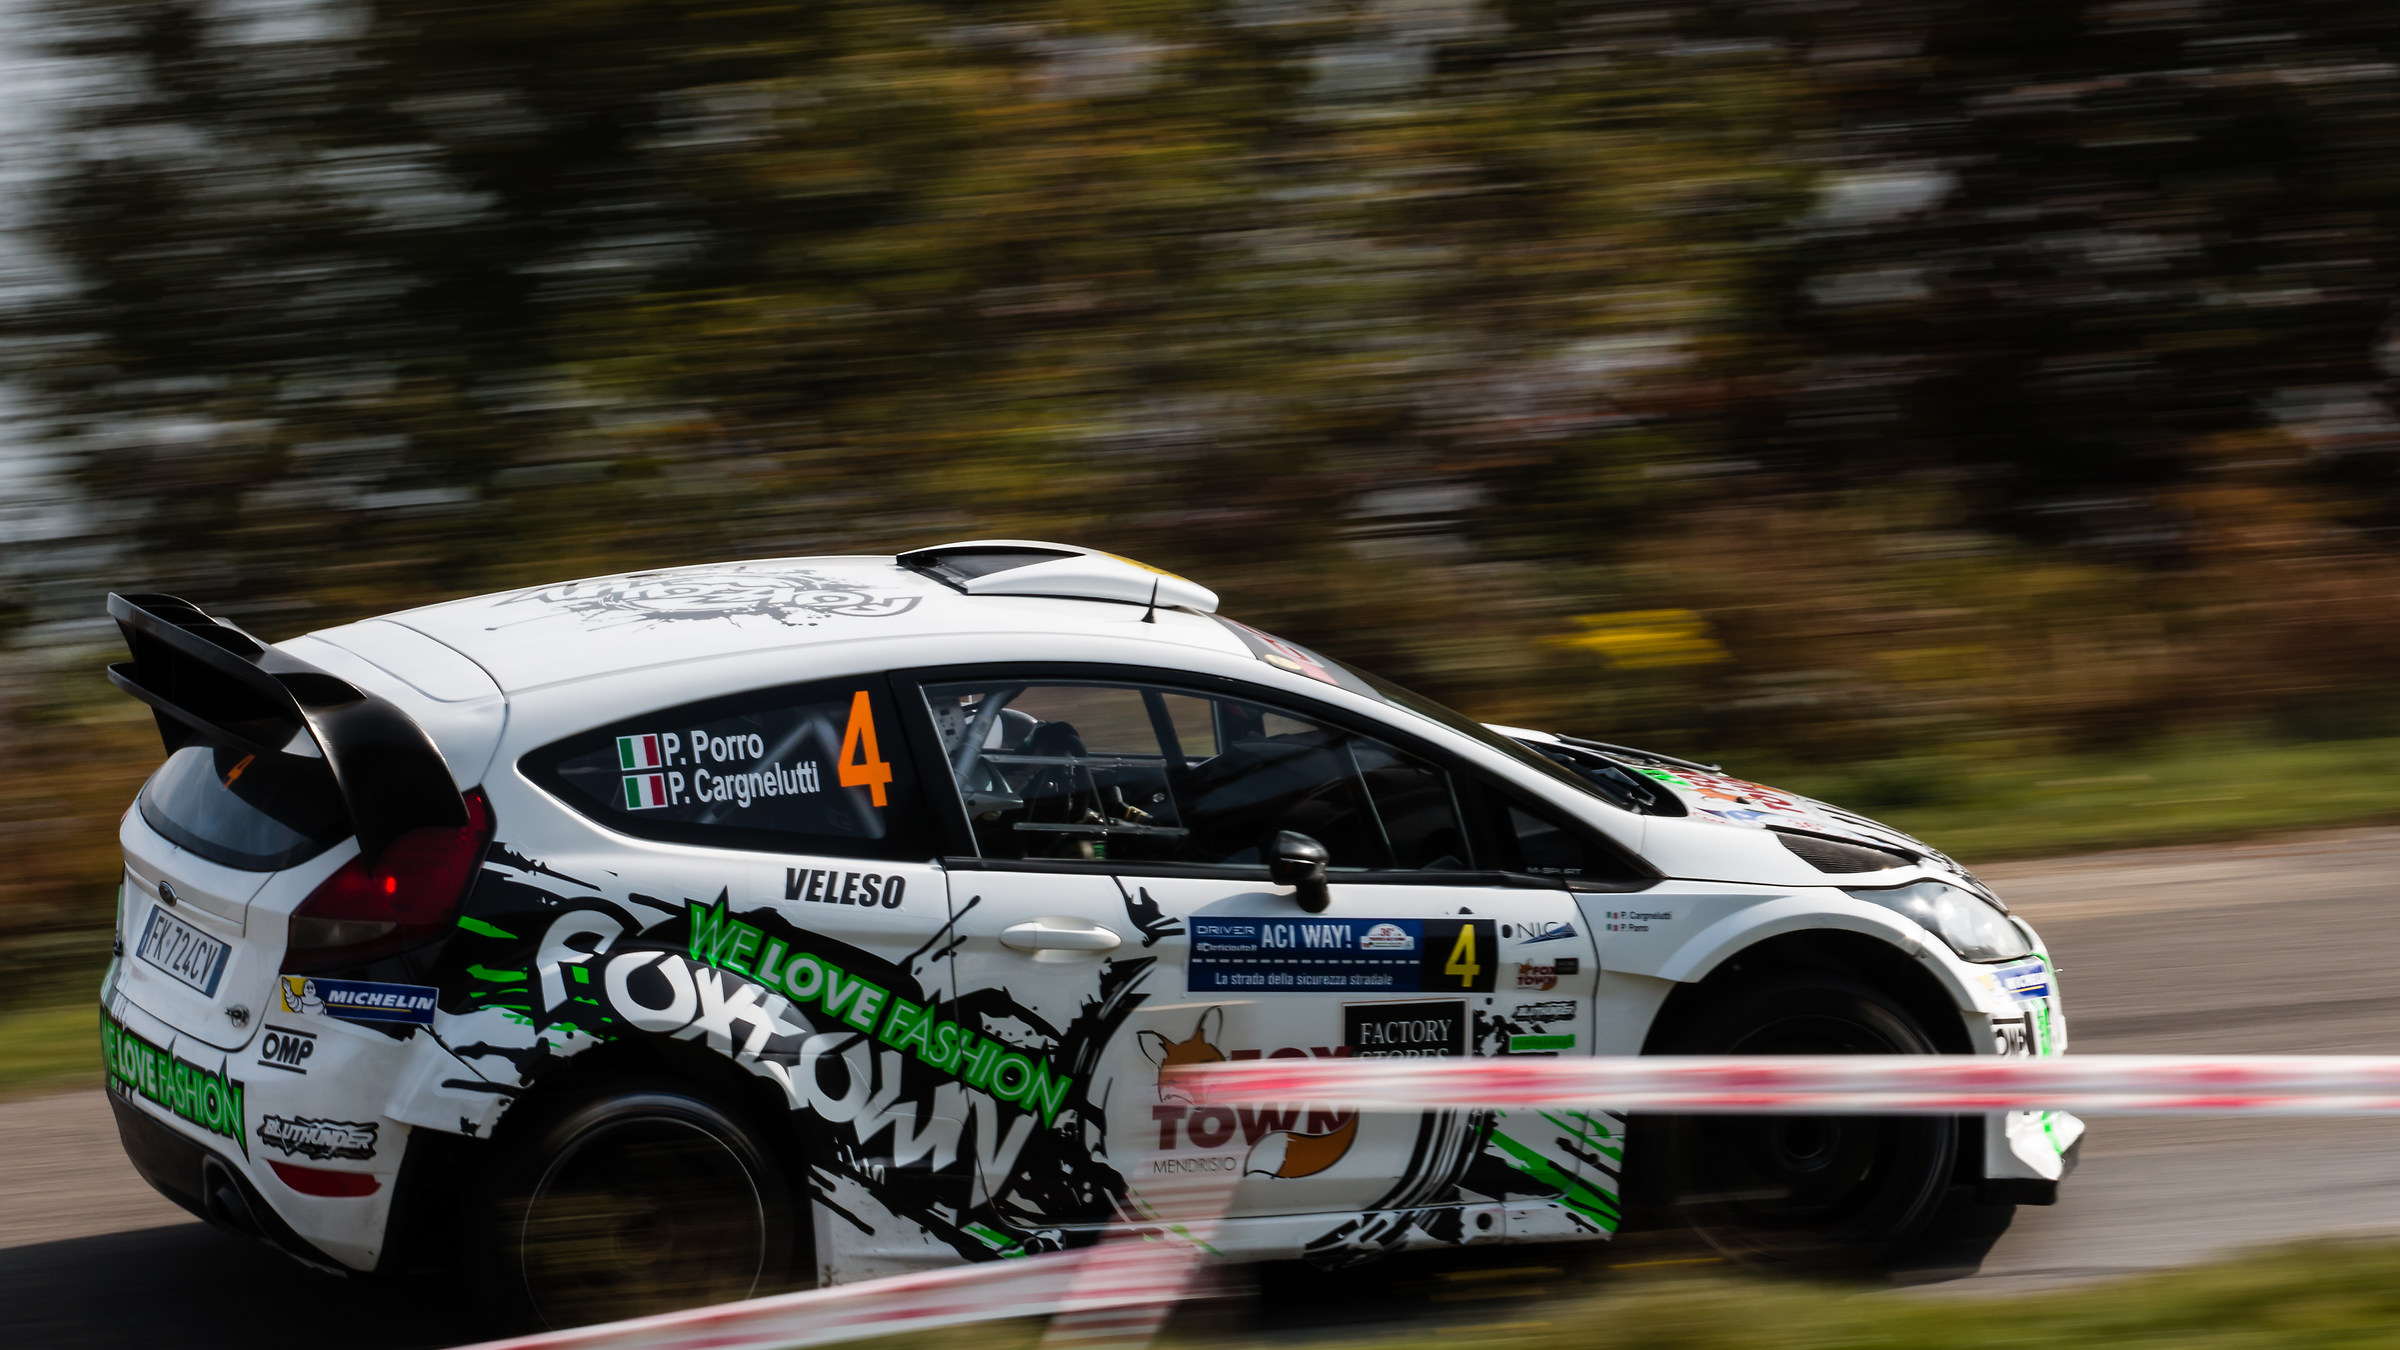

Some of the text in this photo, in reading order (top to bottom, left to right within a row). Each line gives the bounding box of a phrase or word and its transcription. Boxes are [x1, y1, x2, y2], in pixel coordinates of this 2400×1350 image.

[662, 730, 763, 766] P. Porro
[838, 691, 892, 807] 4
[669, 760, 821, 808] P. Cargnelutti
[785, 868, 906, 909] VELESO
[1196, 925, 1255, 935] DRIVER
[1261, 925, 1352, 949] ACI WAY!
[1445, 924, 1480, 987] 4
[1215, 972, 1393, 986] La strada della sicurezza stradale
[328, 990, 434, 1010] MICHELIN
[690, 902, 1074, 1130] WE LOVE FASHION
[262, 1032, 314, 1066] OMP
[1360, 1019, 1452, 1045] FACTORY
[116, 1027, 158, 1098] LOVE
[156, 1050, 244, 1148] FASHION
[1152, 1156, 1237, 1174] MENDRISIO
